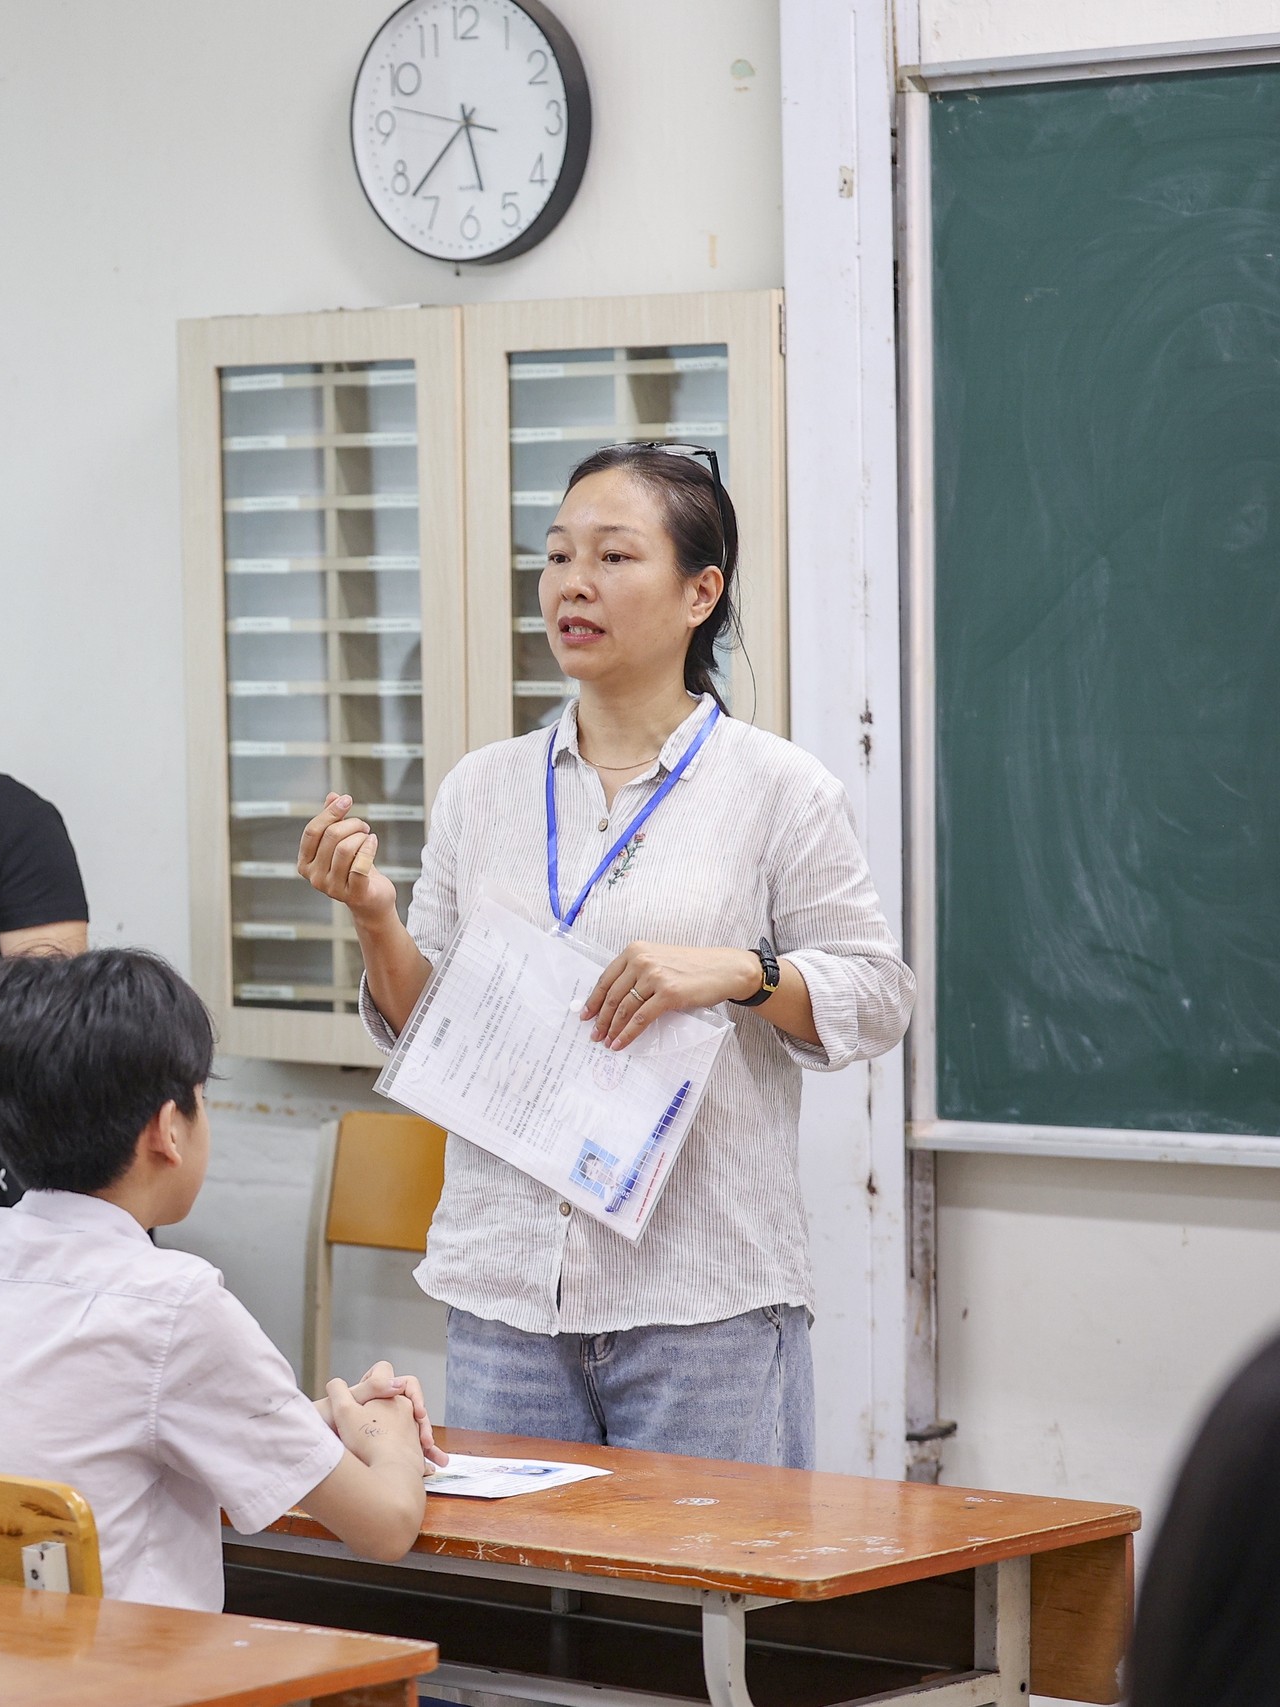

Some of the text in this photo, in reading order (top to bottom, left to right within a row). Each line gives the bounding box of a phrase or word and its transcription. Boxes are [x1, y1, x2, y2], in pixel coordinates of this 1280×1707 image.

[418, 23, 440, 58] 11
[452, 4, 480, 40] 12
[503, 15, 510, 51] 1
[389, 61, 422, 97] 10
[527, 49, 549, 86] 2
[375, 109, 396, 146] 9
[545, 99, 564, 137] 3
[390, 159, 411, 197] 8
[528, 152, 549, 188] 4
[422, 195, 440, 232] 7
[460, 205, 481, 242] 6
[501, 191, 521, 228] 5
